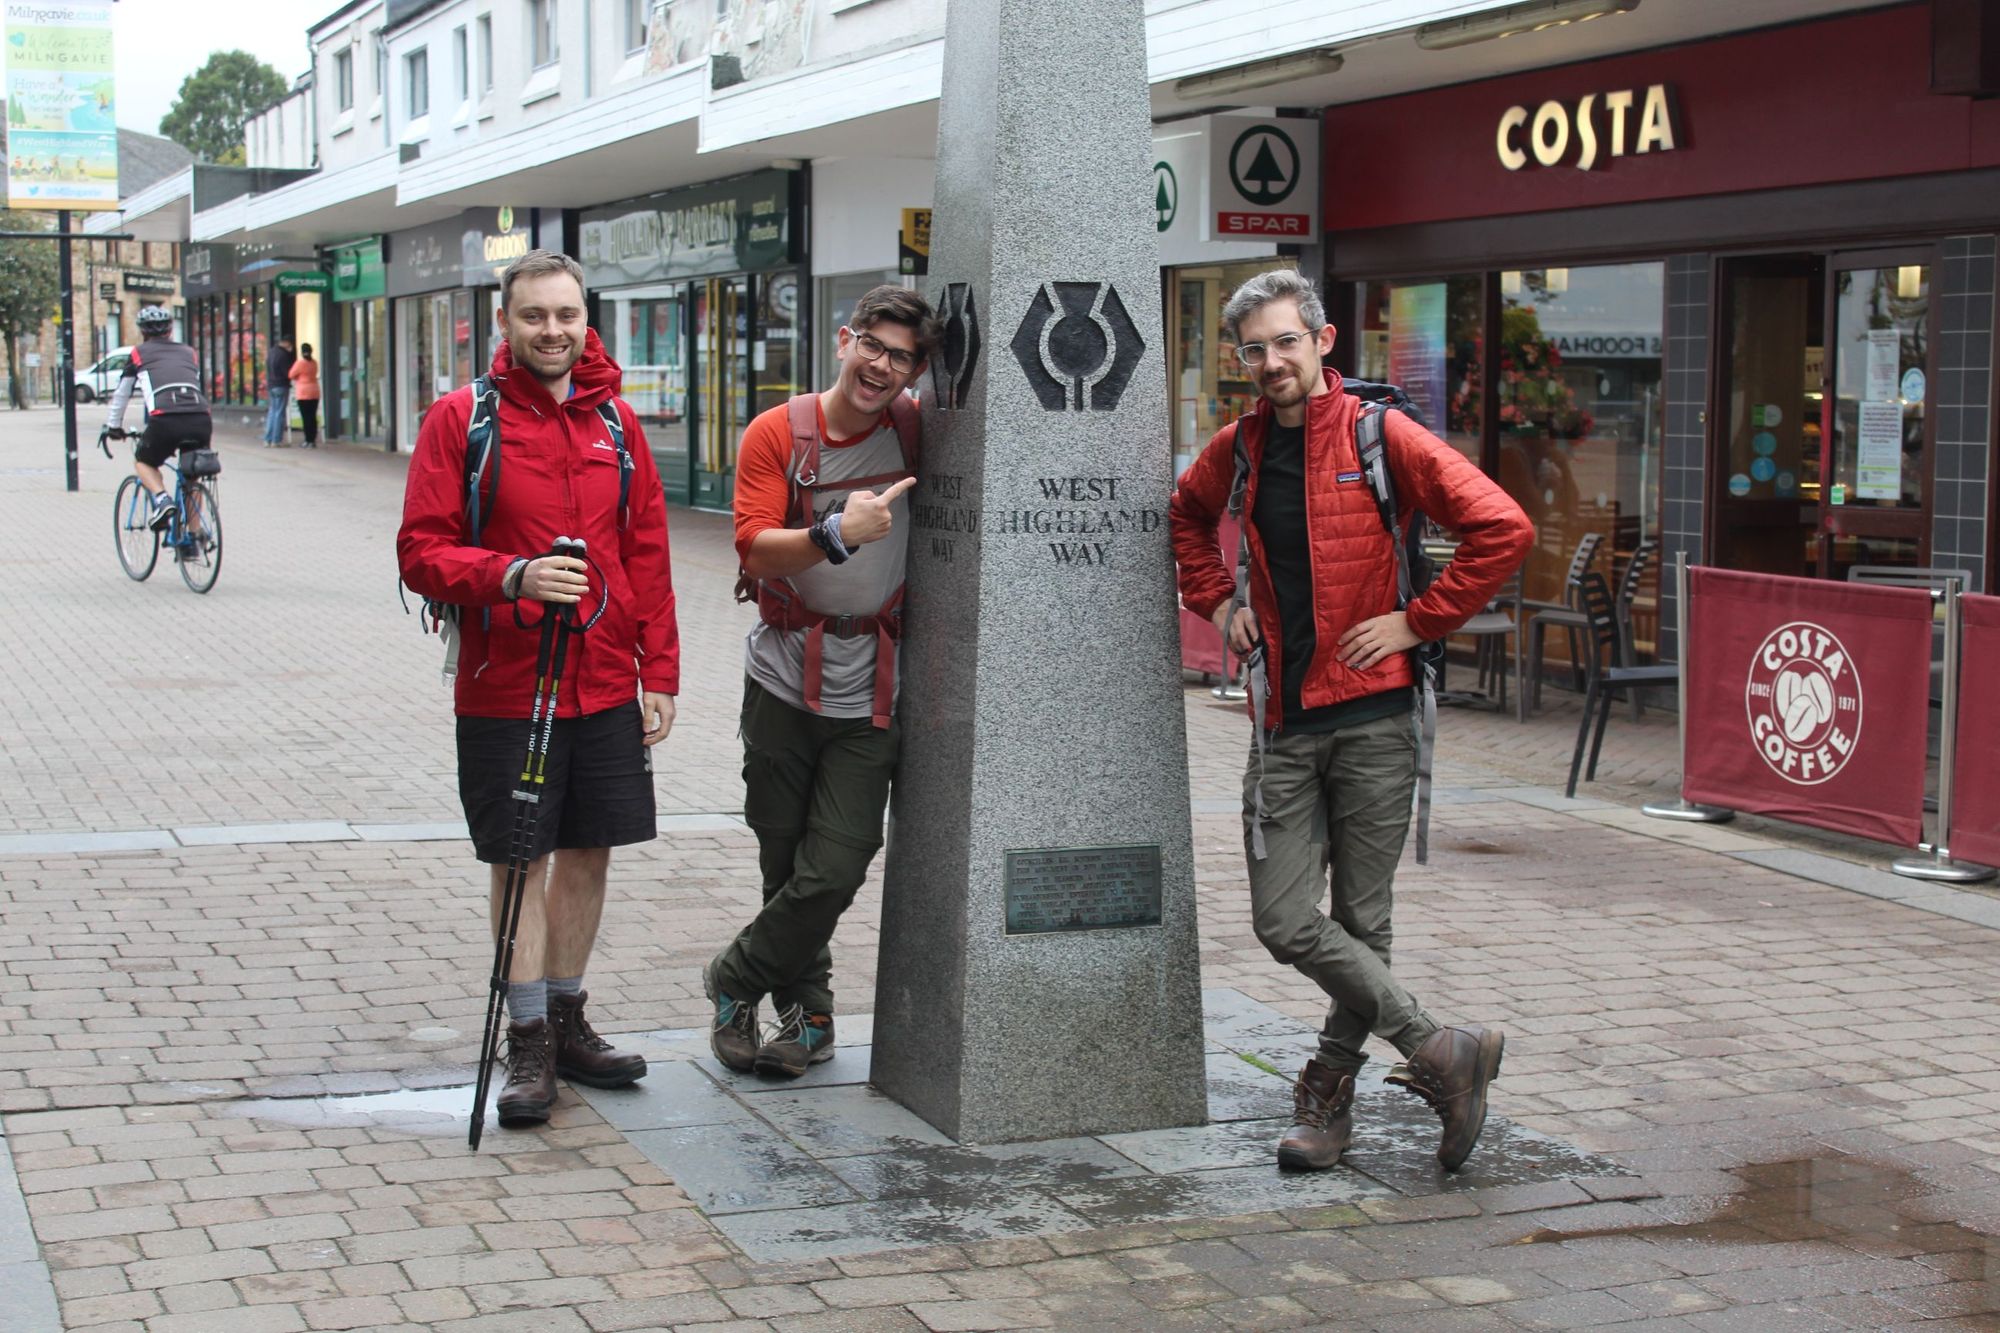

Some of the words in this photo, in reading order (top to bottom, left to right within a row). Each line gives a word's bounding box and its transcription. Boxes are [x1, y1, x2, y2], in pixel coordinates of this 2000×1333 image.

[14, 52, 108, 64] MILNGAVIE
[1497, 84, 1674, 171] COSTA
[608, 212, 662, 264] HOLLAND
[677, 200, 736, 246] BARRETT
[1229, 216, 1299, 232] SPAR
[280, 276, 327, 289] Specsavers
[931, 474, 963, 499] WEST
[1039, 478, 1121, 501] WEST
[914, 504, 977, 533] HIGHLAND
[999, 510, 1160, 534] HIGHLAND
[931, 538, 956, 562] WAY
[1049, 543, 1113, 566] WAY
[1763, 629, 1844, 680] COSTA
[1750, 682, 1771, 698] SINCE
[1838, 696, 1856, 711] 1971
[1755, 714, 1851, 779] COFFEE
